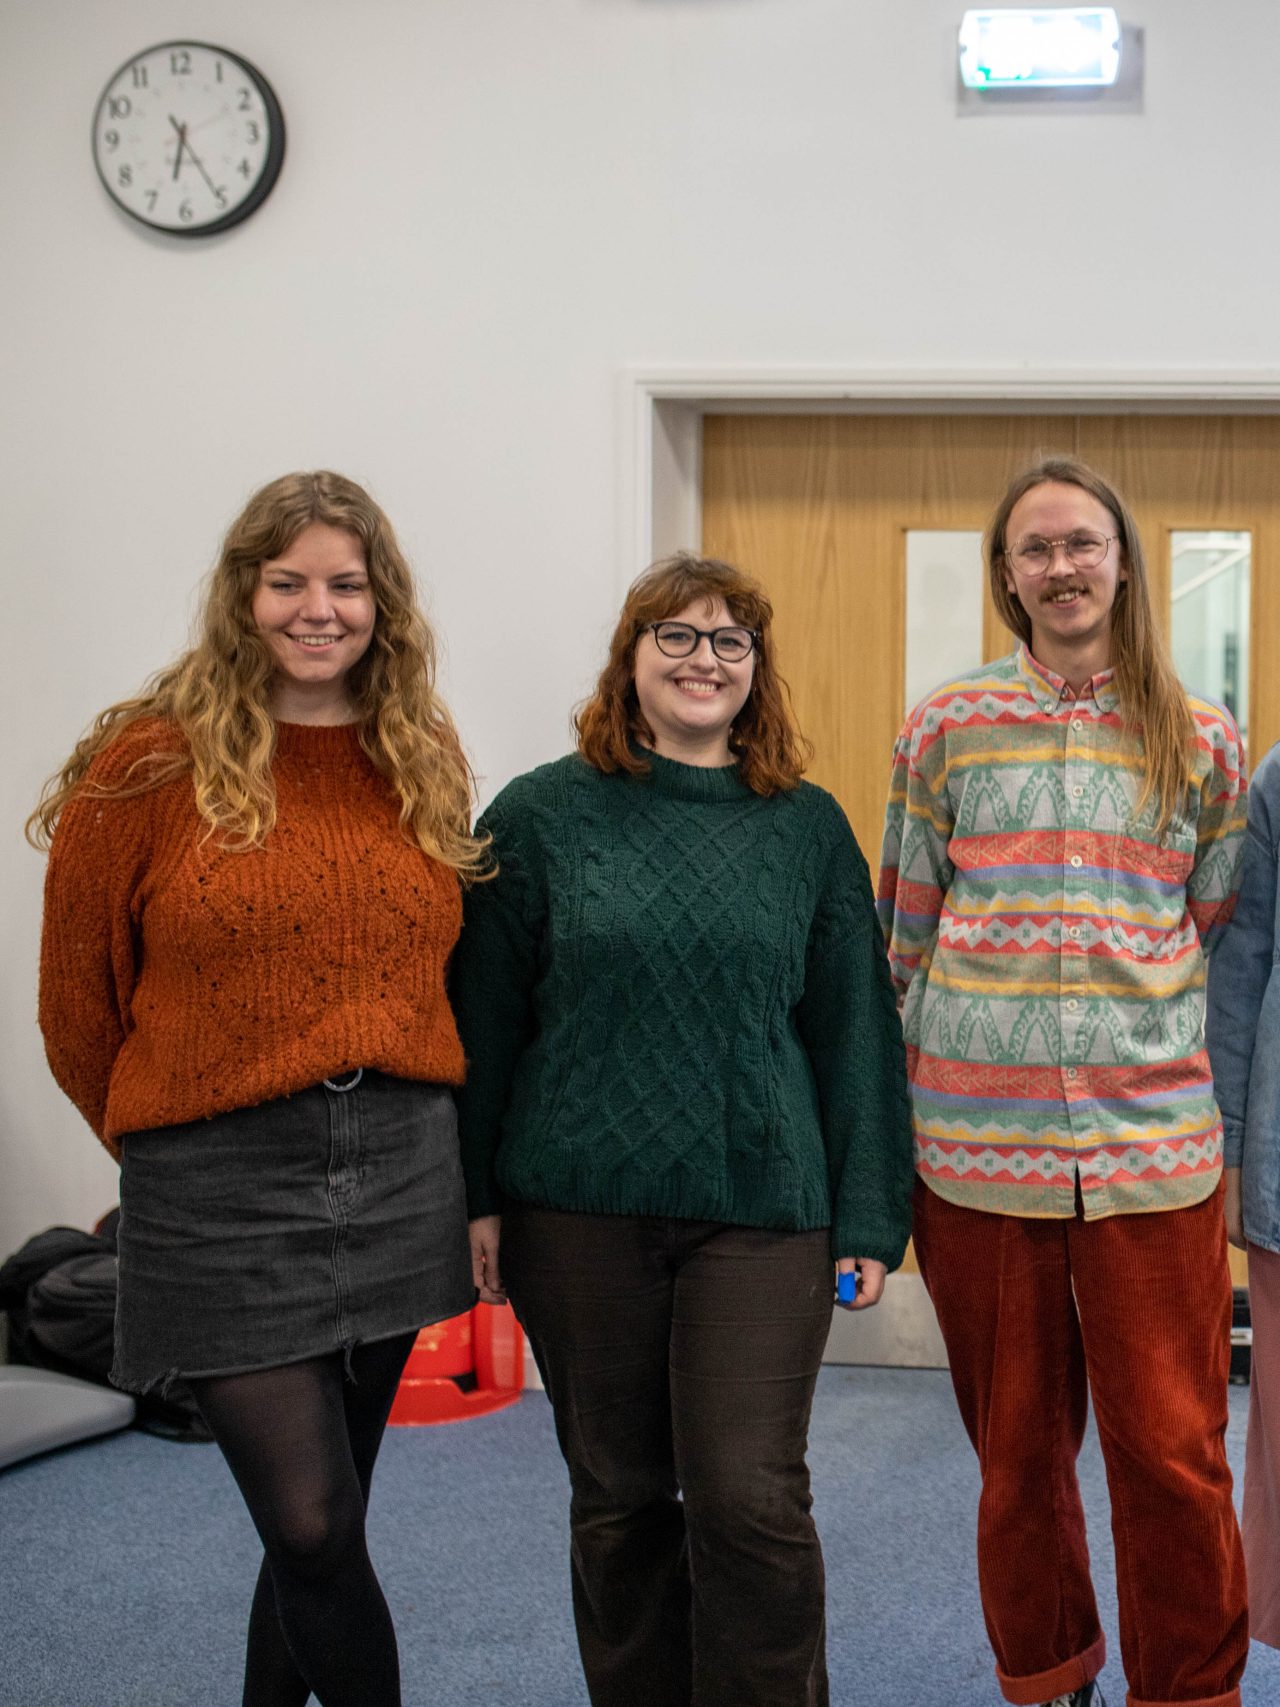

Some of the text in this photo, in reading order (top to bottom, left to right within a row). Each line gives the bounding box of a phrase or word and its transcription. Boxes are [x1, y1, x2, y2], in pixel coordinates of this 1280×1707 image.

[169, 52, 192, 75] 12
[215, 61, 223, 83] 1
[132, 65, 149, 88] 11
[107, 95, 132, 119] 10
[236, 88, 252, 111] 2
[104, 131, 120, 154] 9
[245, 121, 259, 144] 3
[119, 165, 133, 187] 8
[236, 158, 251, 179] 4
[144, 190, 159, 213] 7
[215, 186, 229, 209] 5
[178, 197, 194, 222] 6
